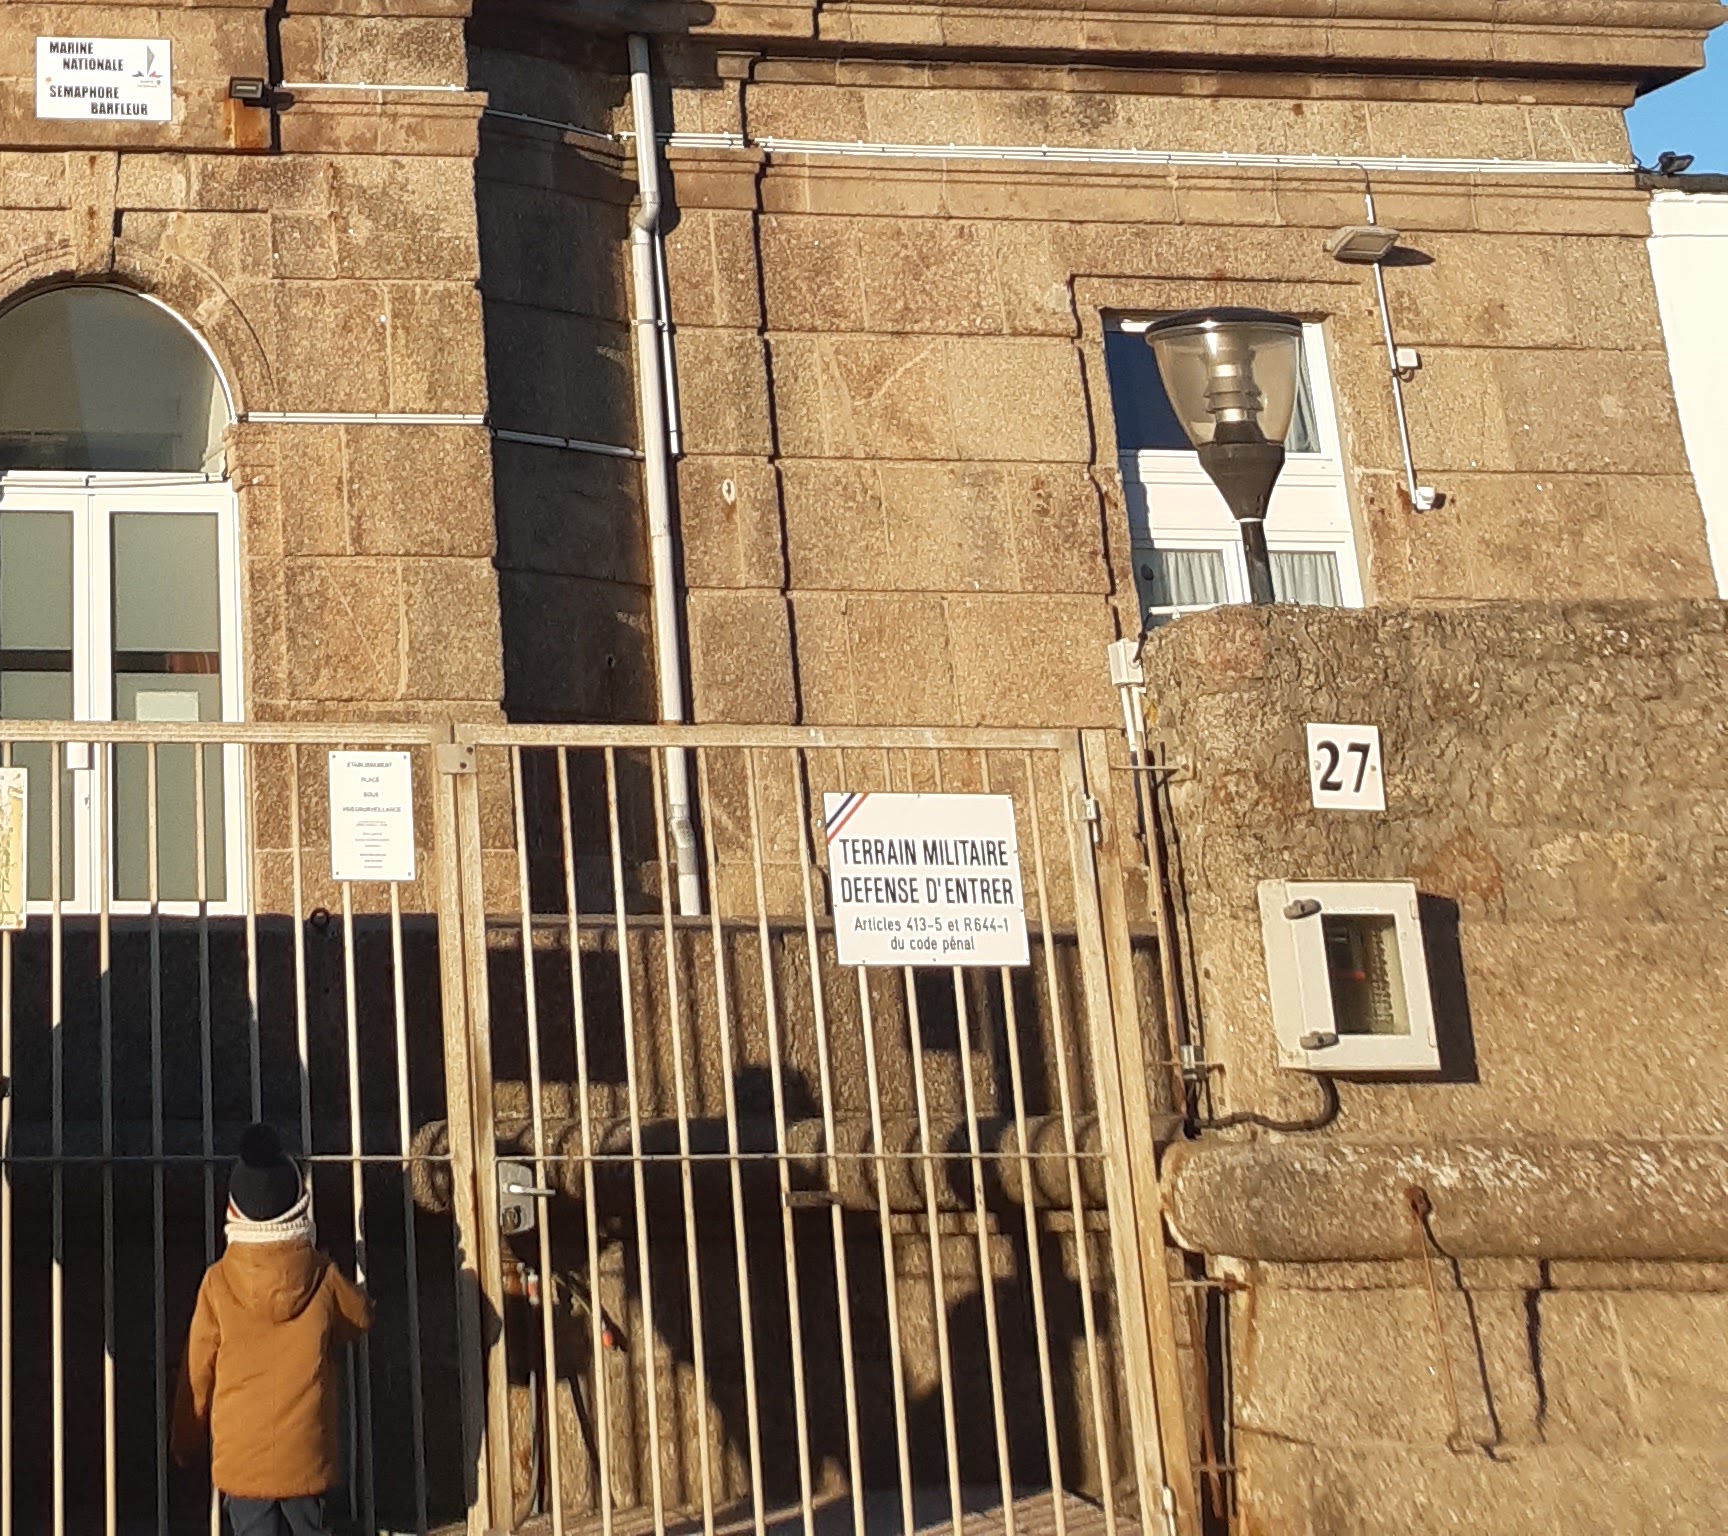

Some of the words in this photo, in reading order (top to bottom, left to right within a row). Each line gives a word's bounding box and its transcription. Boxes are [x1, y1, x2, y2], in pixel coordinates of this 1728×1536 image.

[49, 41, 93, 54] MARINE
[63, 58, 124, 71] NATIONALE
[49, 85, 120, 99] SEMAPHORE
[91, 102, 148, 115] BARFLEUR
[1316, 740, 1371, 793] 27
[839, 838, 918, 866] TERRAIN
[923, 839, 1009, 866] MILITAIRE
[840, 877, 920, 904] DEFENSE
[926, 878, 1015, 905] D'ENTRER
[854, 916, 902, 932] Articles
[906, 917, 943, 932] 413-5
[948, 918, 960, 932] et
[890, 936, 905, 950] du
[910, 936, 938, 950] code
[943, 936, 976, 954] pénal
